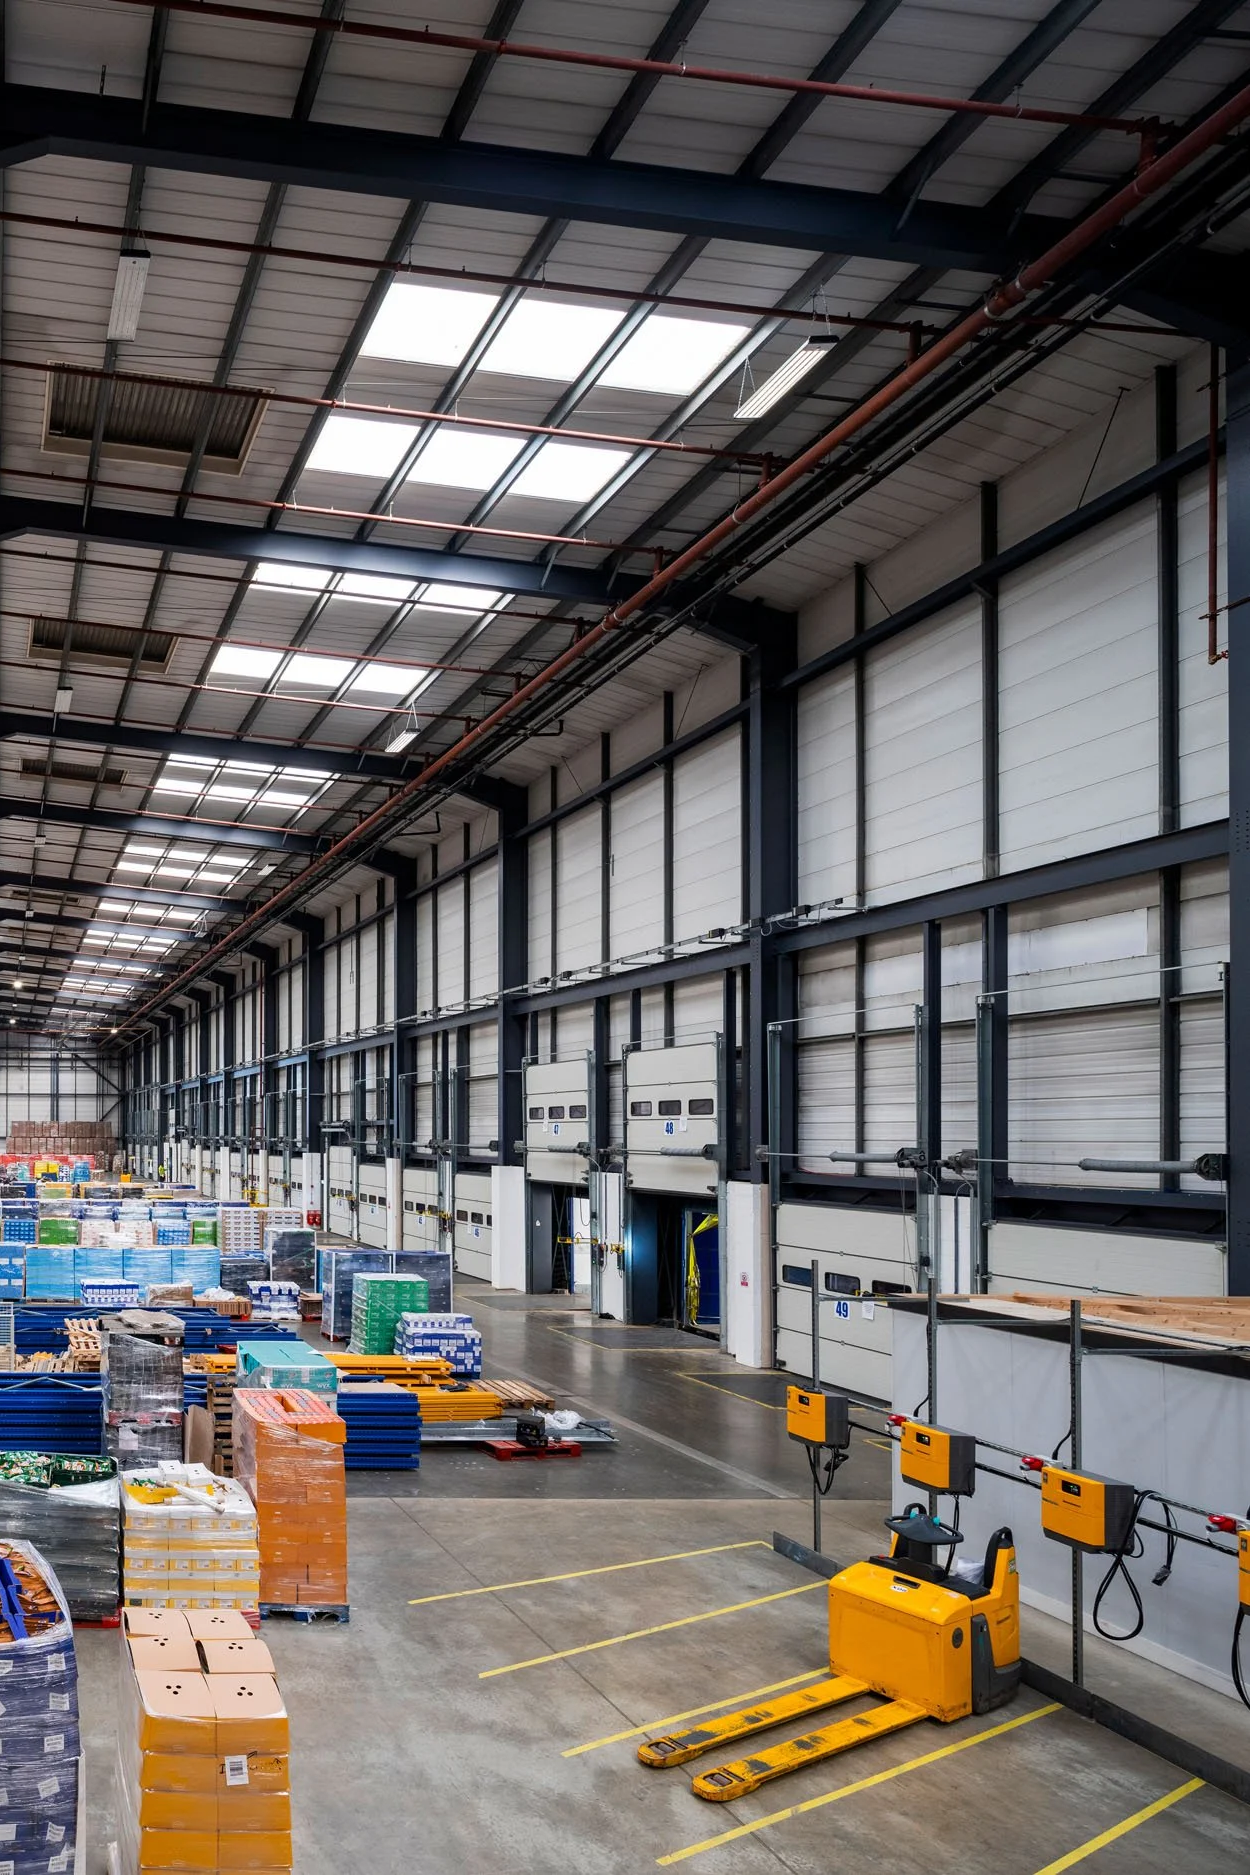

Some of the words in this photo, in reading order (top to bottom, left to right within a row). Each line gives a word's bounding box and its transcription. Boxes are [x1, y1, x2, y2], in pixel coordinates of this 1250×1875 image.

[553, 1124, 559, 1135] 47
[665, 1121, 674, 1135] 48
[836, 1301, 849, 1318] 49
